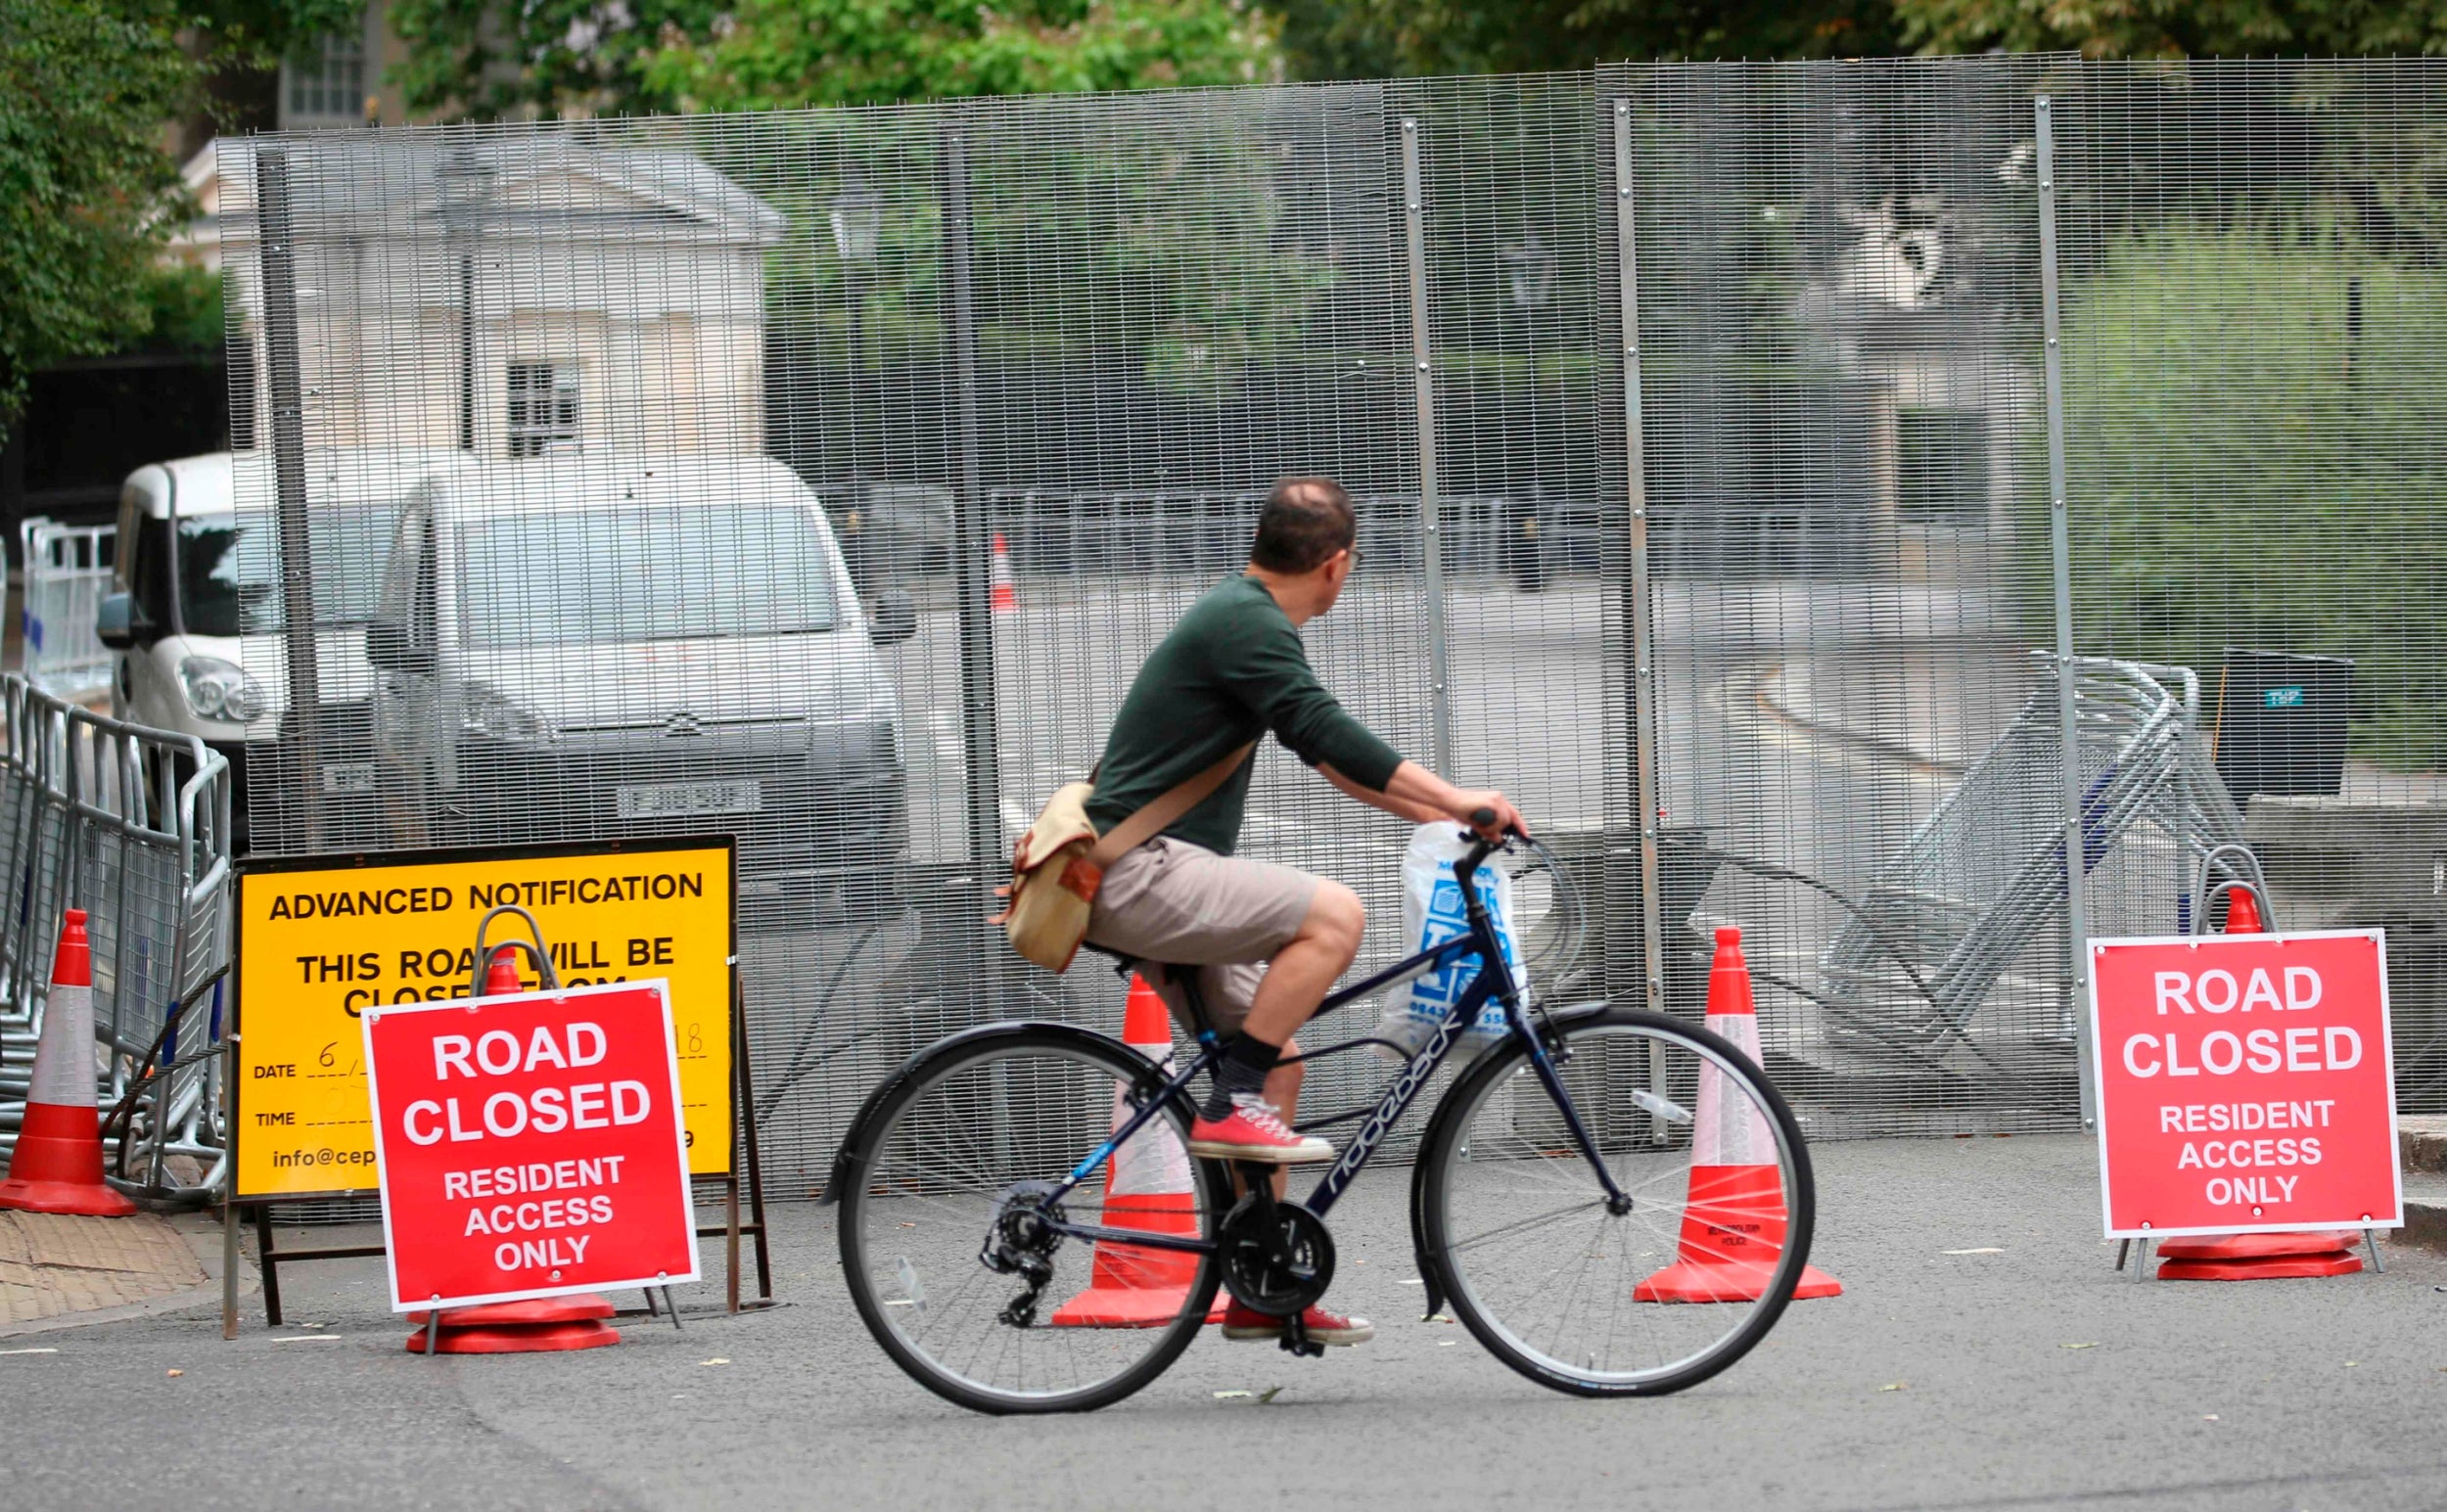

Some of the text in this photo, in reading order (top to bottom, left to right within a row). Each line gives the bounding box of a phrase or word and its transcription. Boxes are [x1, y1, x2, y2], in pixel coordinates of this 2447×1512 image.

[269, 873, 703, 921] ADVANCED NOTIFICATION
[297, 952, 381, 984] THIS
[399, 947, 491, 979] ROA
[627, 937, 674, 967] BE
[2154, 966, 2323, 1015] ROAD
[254, 1064, 297, 1079] DATE
[433, 1022, 607, 1080] ROAD
[2123, 1026, 2363, 1078] CLOSED
[255, 1112, 296, 1125] TIME
[403, 1079, 651, 1146] CLOSED
[1327, 1011, 1462, 1194] ridgeback
[2160, 1100, 2335, 1133] RESIDENT
[2177, 1137, 2322, 1169] ACCESS
[444, 1156, 624, 1200] RESIDENT
[2205, 1175, 2299, 1206] ONLY
[464, 1195, 613, 1237] ACCESS
[494, 1235, 590, 1271] ONLY
